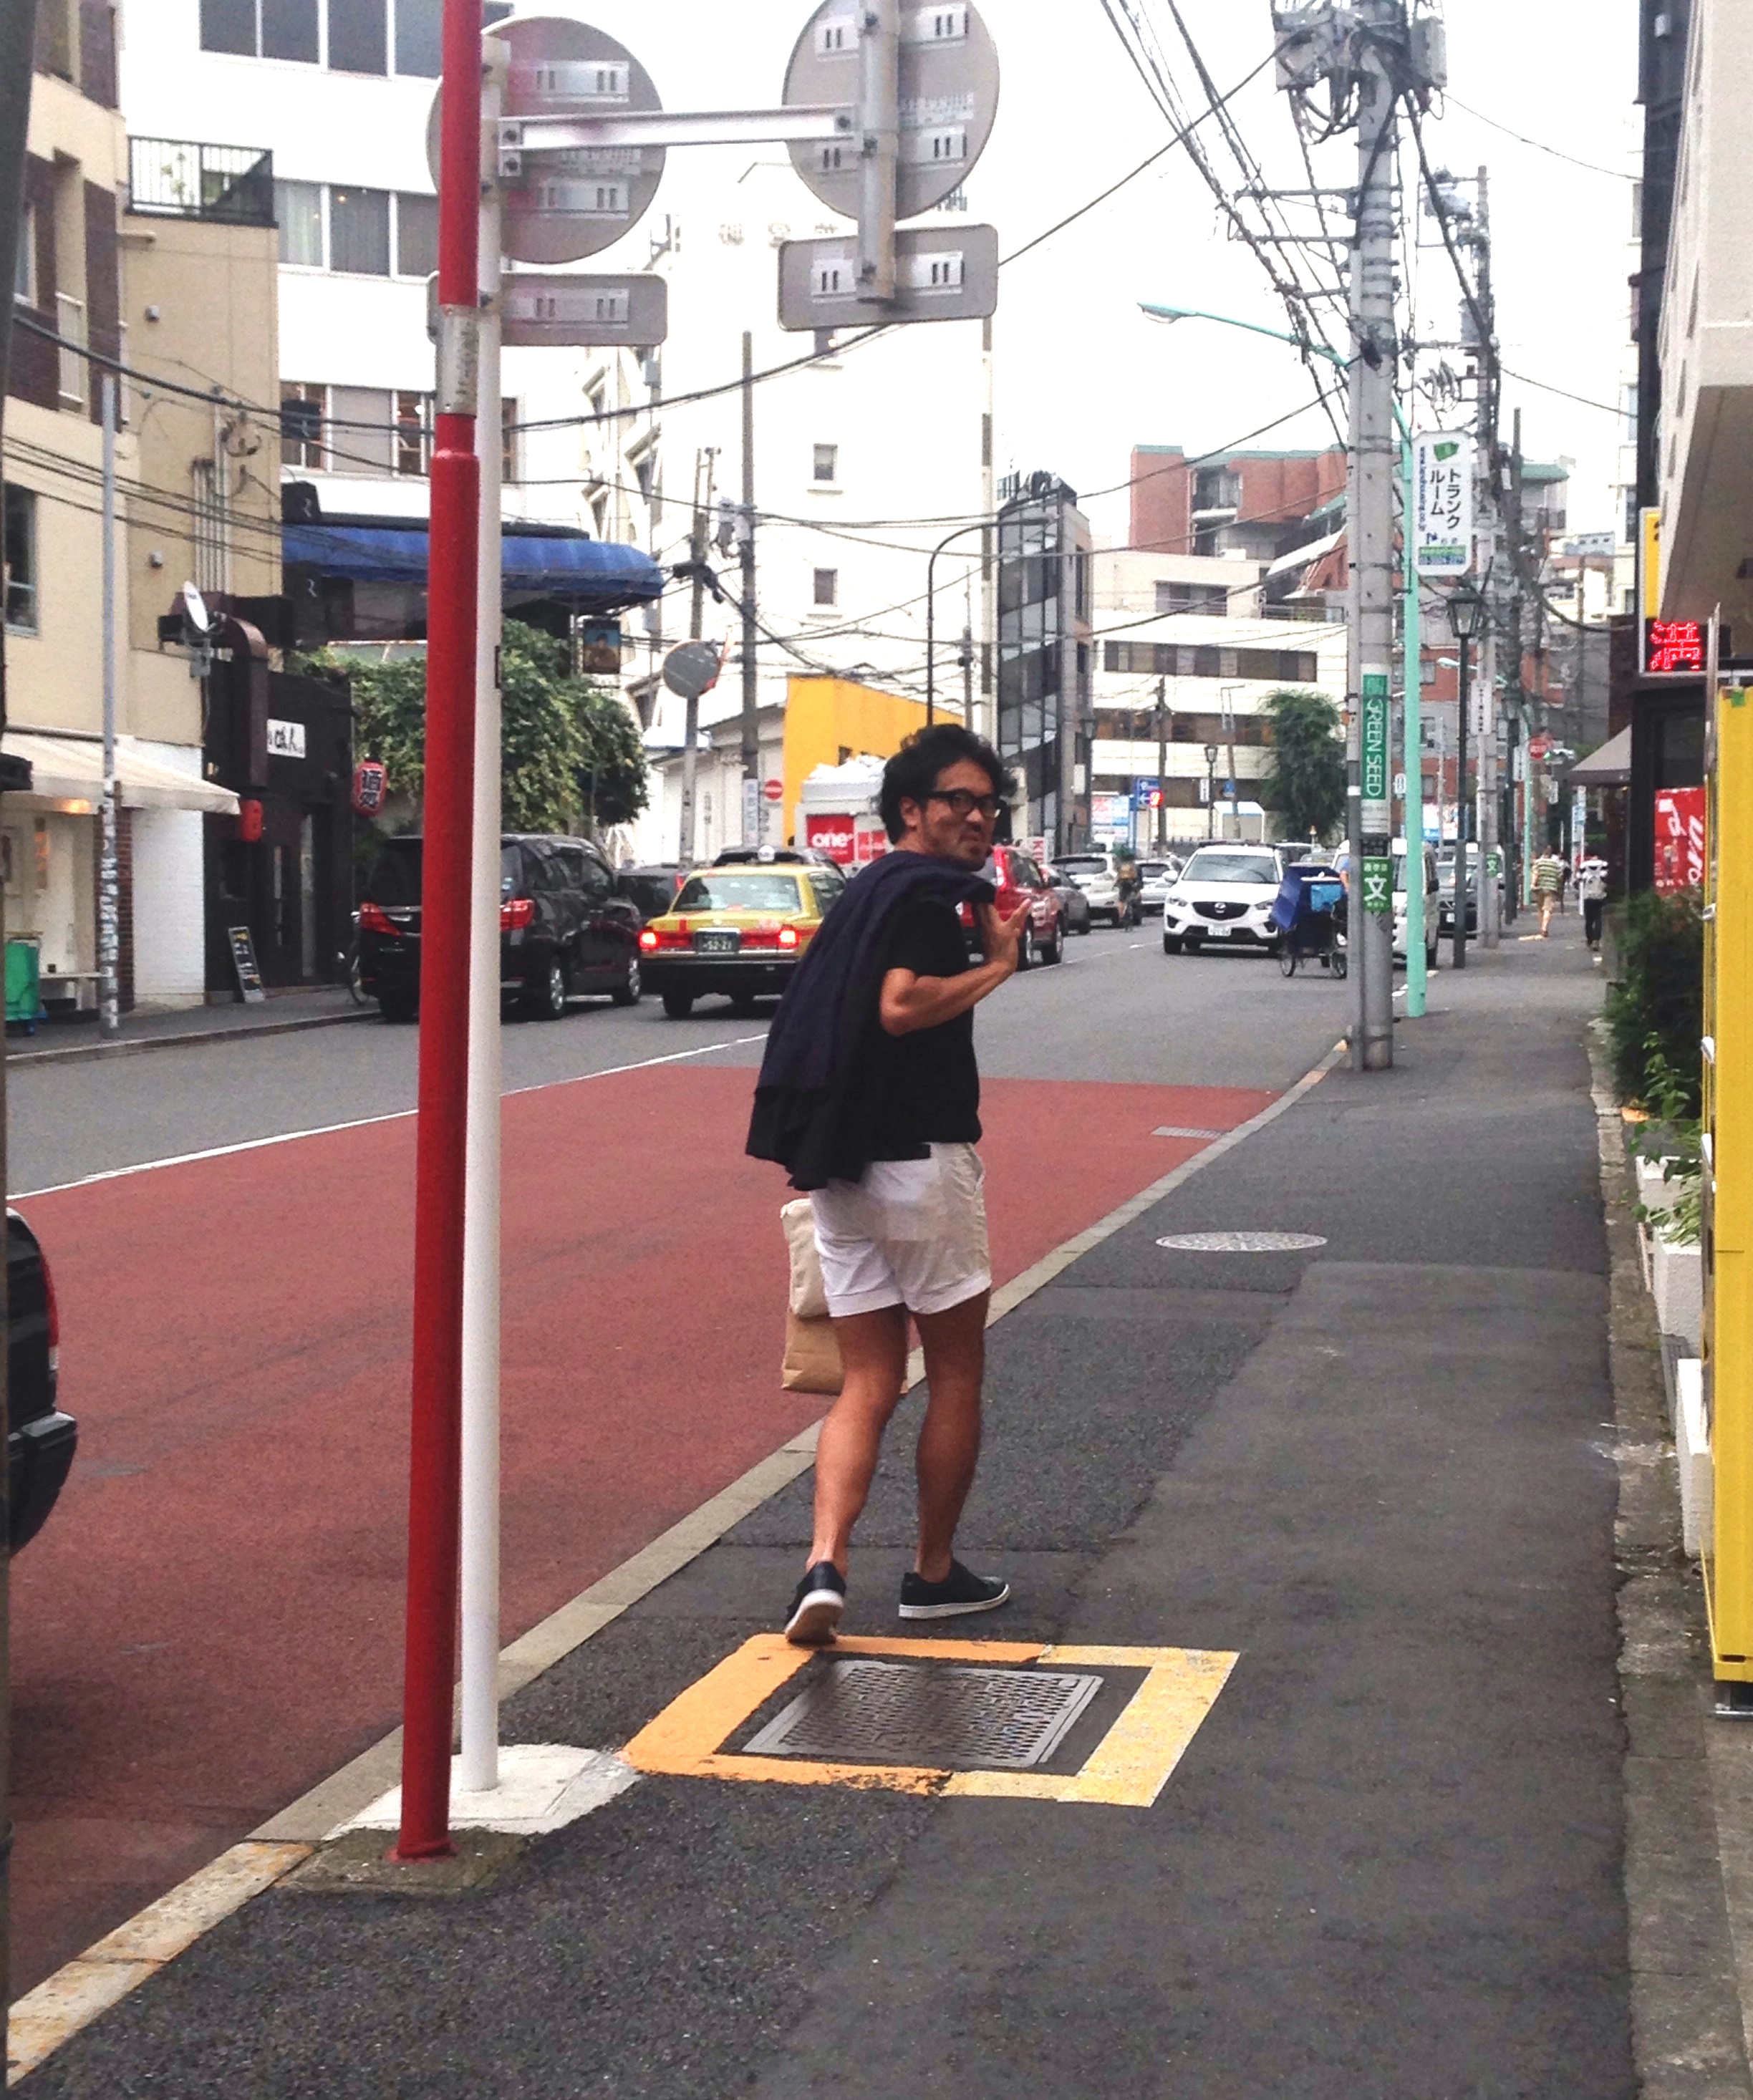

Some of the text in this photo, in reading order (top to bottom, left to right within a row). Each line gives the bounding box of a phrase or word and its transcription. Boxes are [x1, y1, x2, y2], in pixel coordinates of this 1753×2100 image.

[1430, 469, 1445, 515] ルーム
[1447, 468, 1461, 529] トランク
[1366, 698, 1383, 752] GREEN
[1366, 754, 1382, 796] SEED
[1363, 874, 1388, 901] 文
